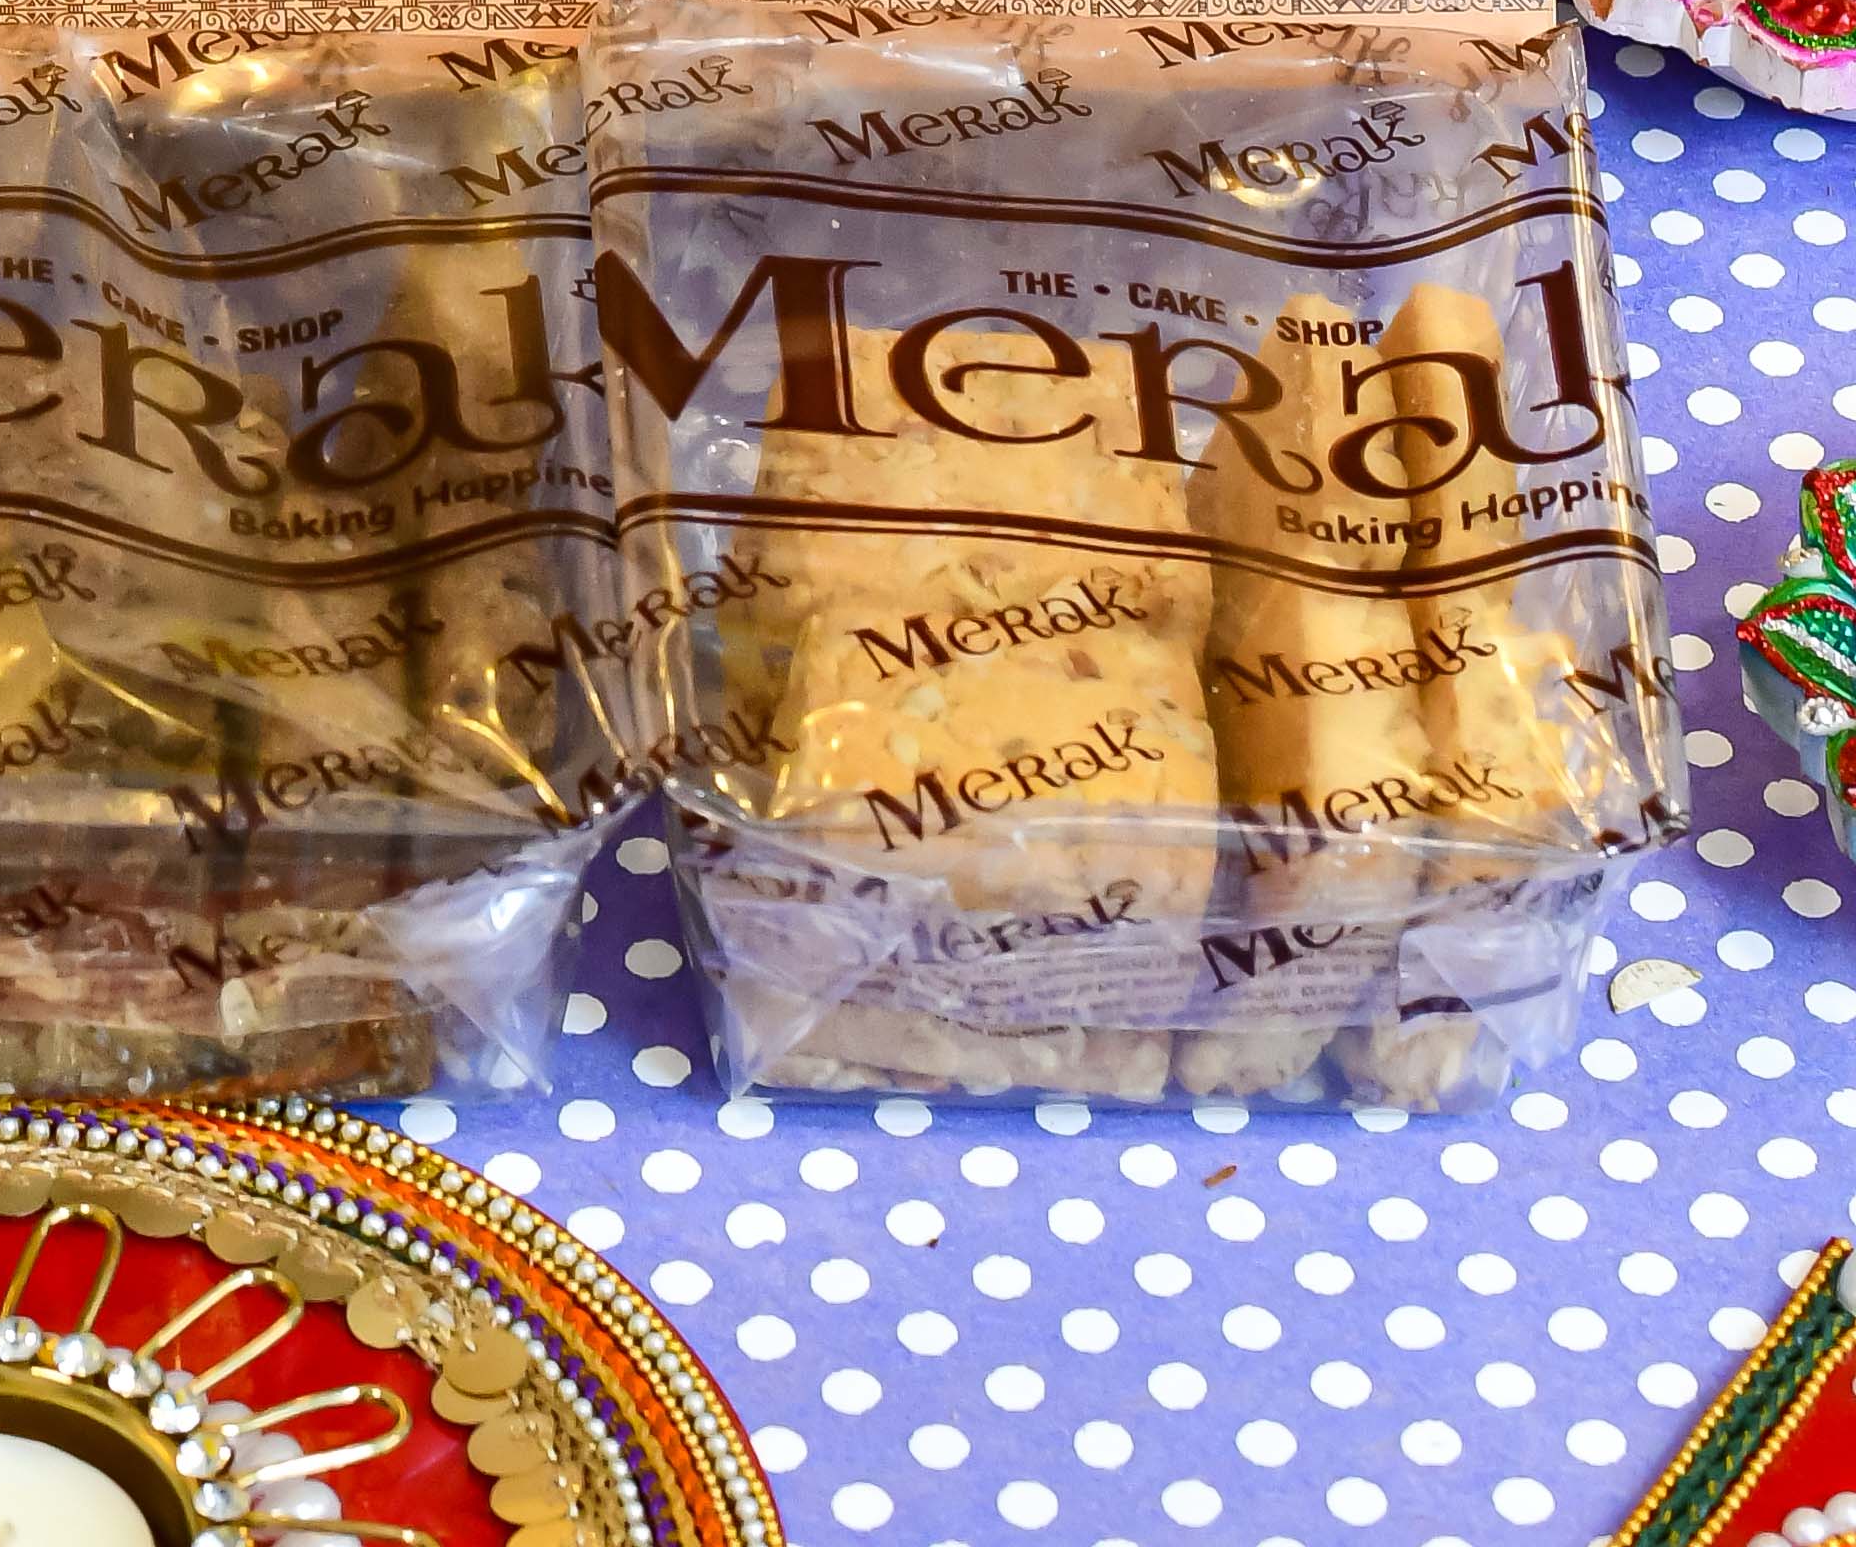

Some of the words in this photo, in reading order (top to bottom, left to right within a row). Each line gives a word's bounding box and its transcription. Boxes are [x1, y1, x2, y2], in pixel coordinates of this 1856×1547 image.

[100, 281, 187, 347] CAKE
[237, 309, 346, 354] SHOP
[999, 270, 1078, 299] THE
[1128, 282, 1228, 325] CAKE
[1276, 317, 1384, 347] SHOP
[229, 505, 396, 542] Baking
[412, 457, 615, 509] Happine
[1276, 505, 1443, 549] Baking
